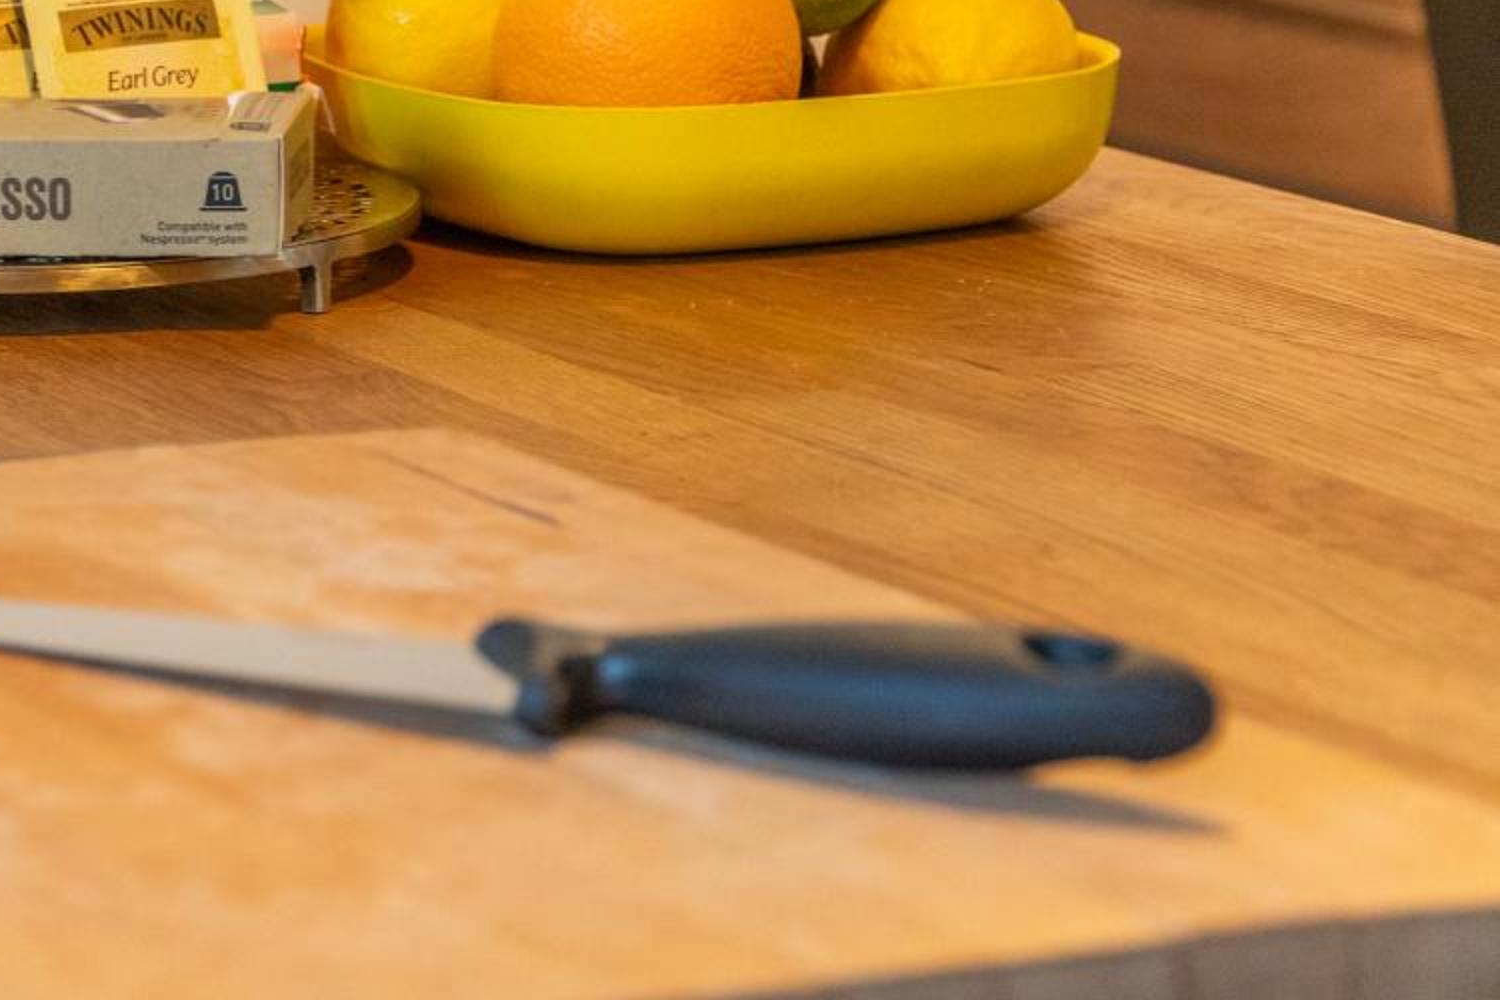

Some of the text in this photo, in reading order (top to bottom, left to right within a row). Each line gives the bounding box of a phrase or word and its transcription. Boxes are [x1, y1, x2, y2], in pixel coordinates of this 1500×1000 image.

[71, 6, 208, 47] TWININGS
[108, 65, 199, 91] Earl Grey
[212, 184, 234, 200] 10
[158, 221, 248, 233] Compatible with
[210, 235, 248, 246] system
